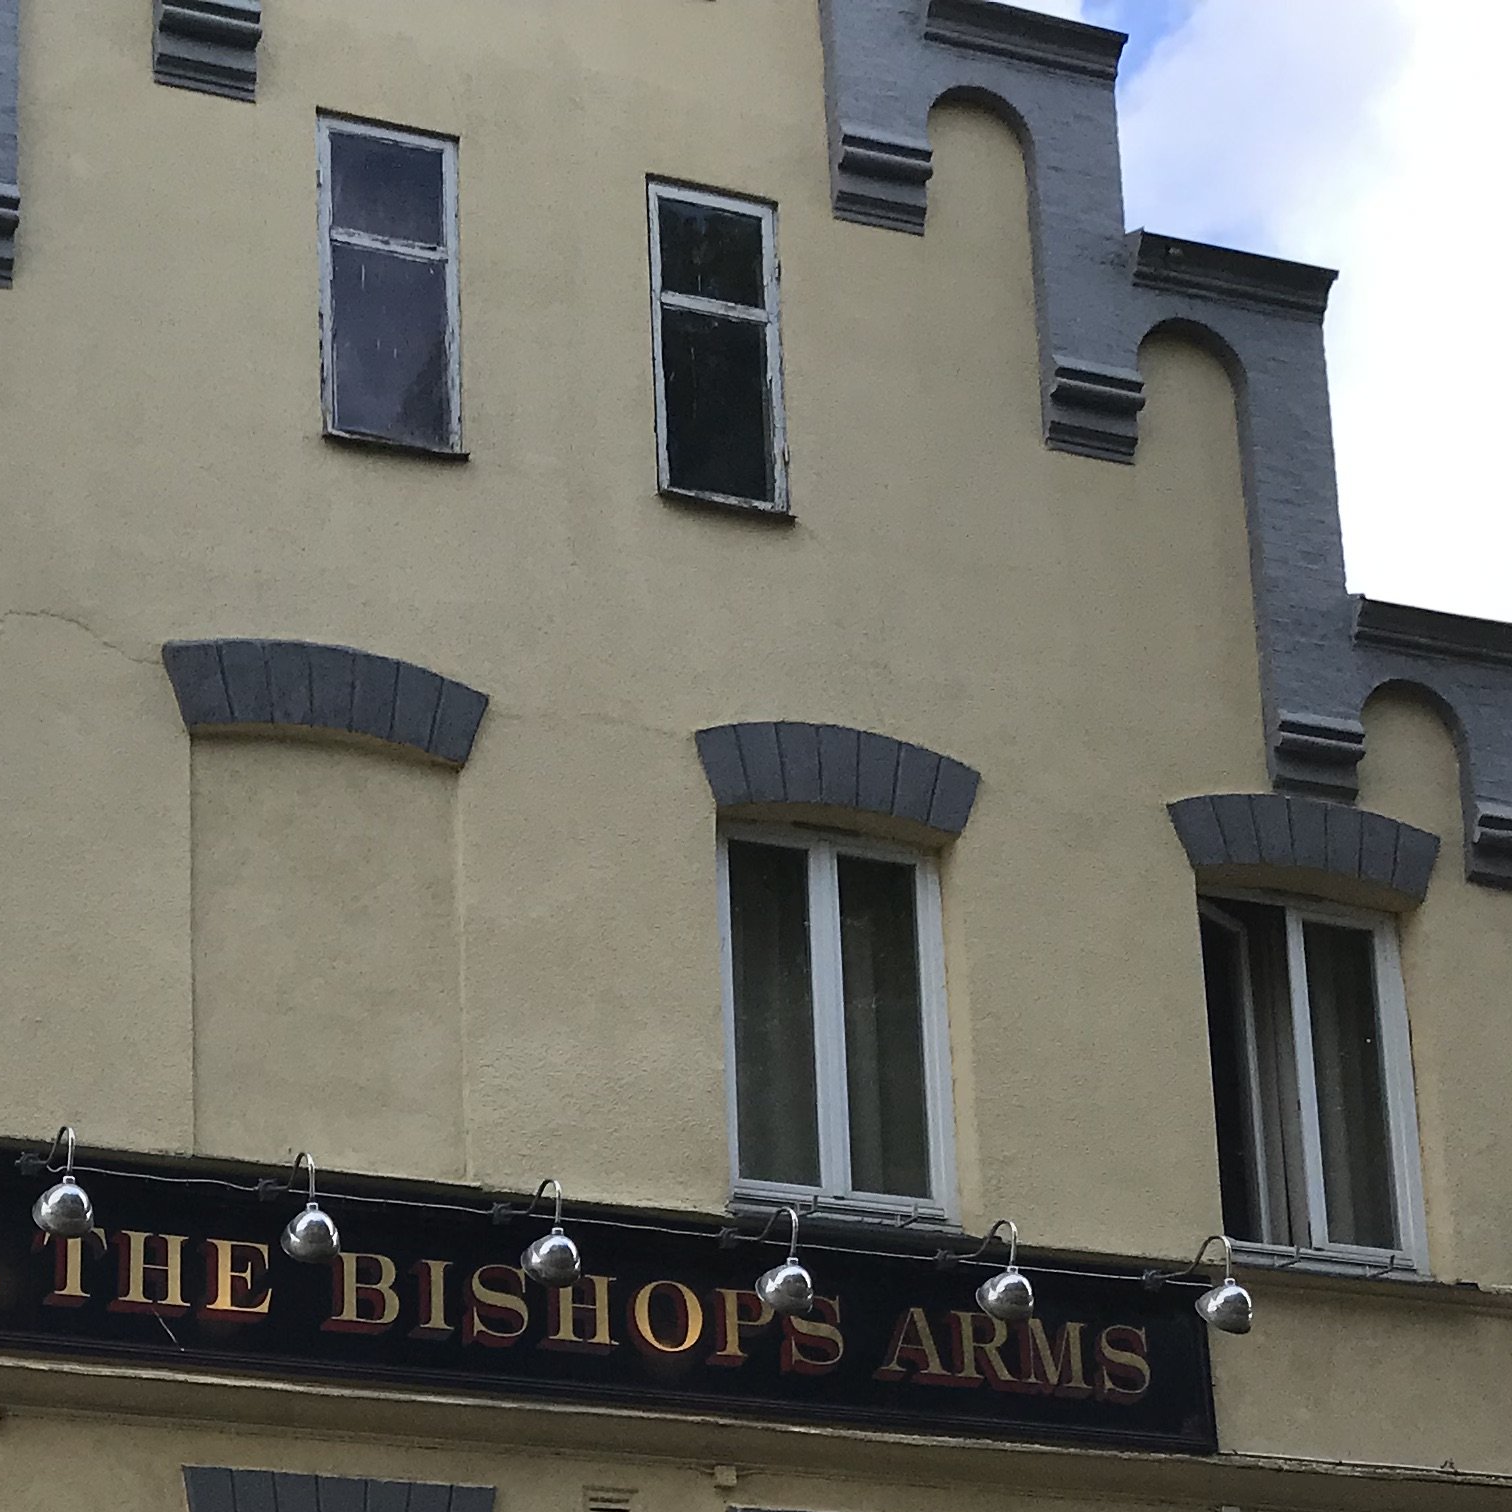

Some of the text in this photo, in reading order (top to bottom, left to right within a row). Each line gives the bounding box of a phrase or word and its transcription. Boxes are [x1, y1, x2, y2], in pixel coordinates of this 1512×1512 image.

[38, 1225, 1154, 1397] THE BISHOPS ARMS
